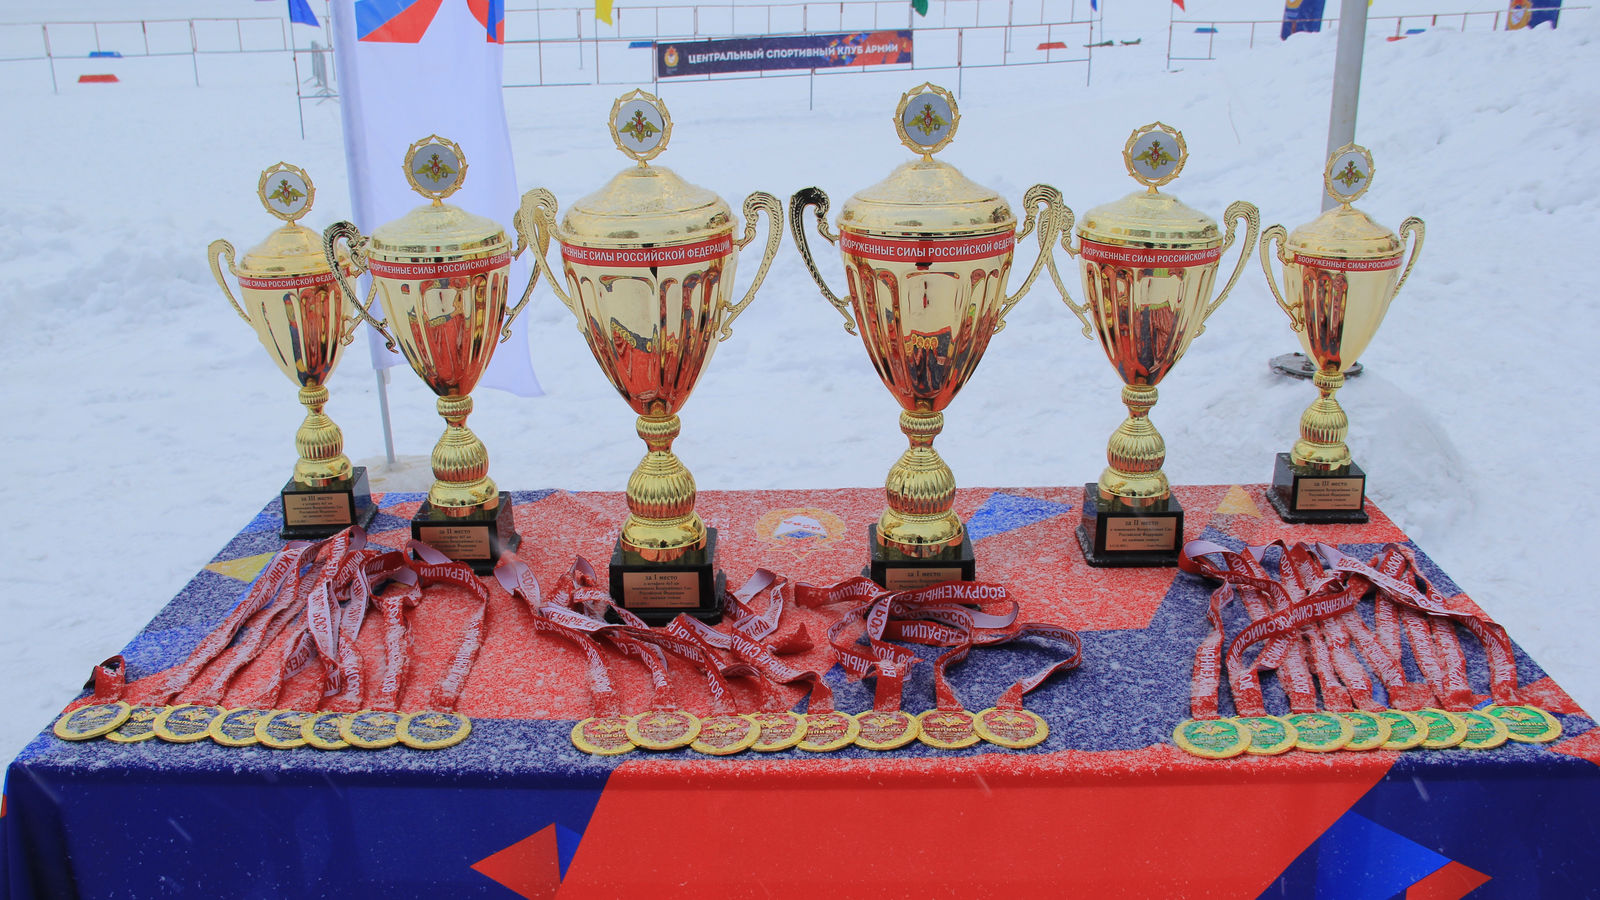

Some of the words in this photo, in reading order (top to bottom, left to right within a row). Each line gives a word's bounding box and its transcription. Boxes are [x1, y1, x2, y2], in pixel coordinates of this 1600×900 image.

[688, 47, 764, 64] ЦЕНТРАЛЬНЫЙ
[766, 45, 835, 59] СПОРТИВНЫЙ
[837, 45, 863, 55] КЛУБ
[865, 43, 898, 54] АРМИИ
[589, 251, 614, 262] СИЛЫ
[616, 247, 685, 262] РОССИЙСКОЙ
[687, 239, 731, 259] ФЕДЕРАЦИИ
[896, 247, 926, 257] СИЛЫ
[928, 243, 992, 257] РОССИЙСКОЙ
[1082, 245, 1130, 262] ВООРУЖЕННЫЕ
[1131, 254, 1156, 263] СИЛЫ
[1157, 251, 1206, 263] РОССИЙСКОЙ
[412, 266, 436, 275] СИЛЫ
[437, 259, 489, 273] РОССИЙСКОЙ
[1347, 261, 1367, 269] СИЛЫ
[268, 276, 315, 288] РОССИЙСКОЙ
[916, 584, 1007, 603] ВООРУЖЕННЫЕ
